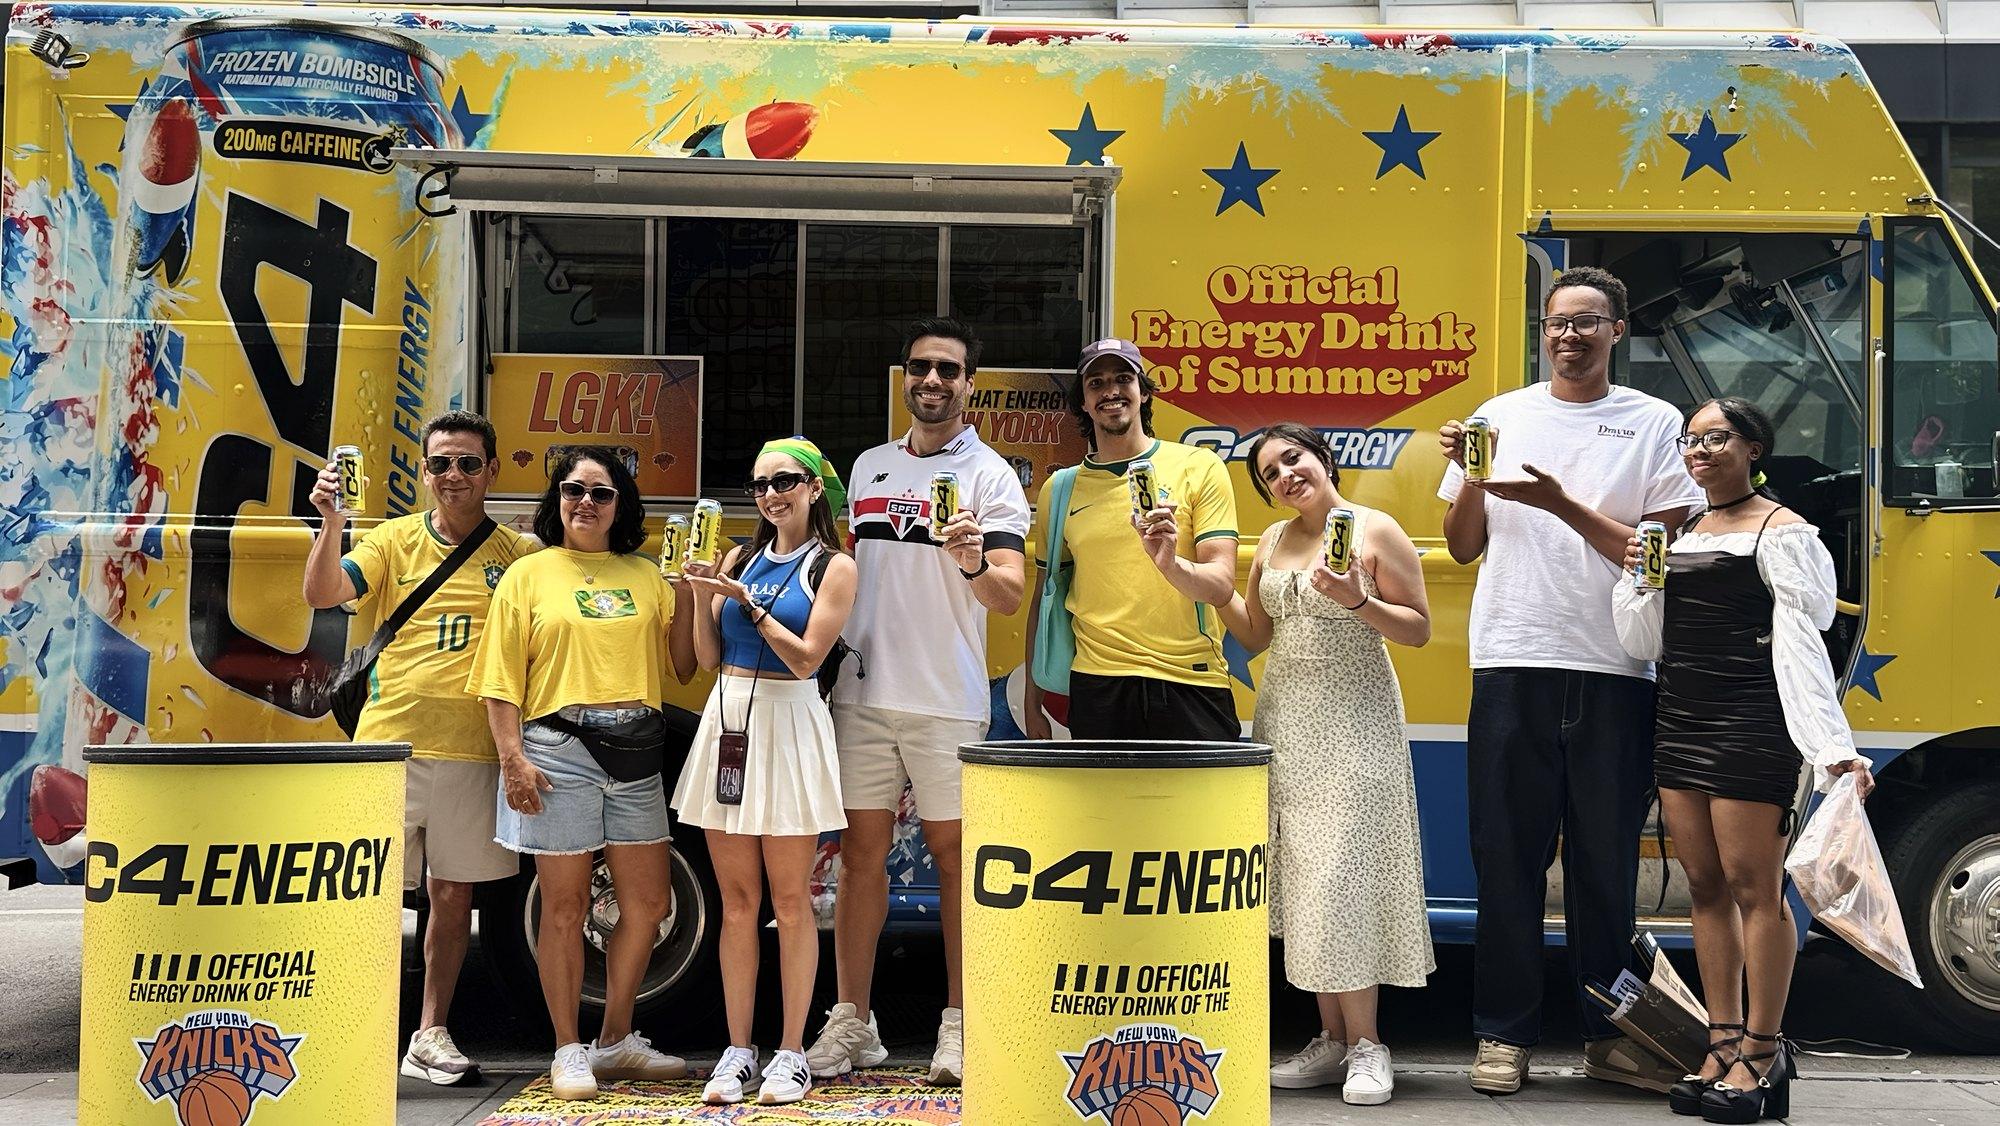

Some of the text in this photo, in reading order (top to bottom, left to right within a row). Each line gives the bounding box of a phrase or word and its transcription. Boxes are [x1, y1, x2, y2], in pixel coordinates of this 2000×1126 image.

[207, 50, 417, 96] FROZEN BOMBSICLE
[223, 74, 399, 103] NATURALLY AND ARTIFICIALLY FLAVORED
[280, 130, 361, 161] CAFFEINE
[1208, 265, 1399, 306] Official
[1132, 309, 1477, 359] Energy Drink
[394, 275, 432, 447] ENERGY
[1146, 355, 1201, 394] of
[527, 371, 664, 435] LGK!
[988, 410, 1065, 444] YORK
[189, 190, 378, 719] C4
[1468, 429, 1480, 467] C4
[345, 459, 359, 497] C4
[1135, 473, 1154, 511] C4
[890, 504, 919, 515] SPFC
[936, 484, 950, 524] C4
[664, 526, 676, 561] C4
[1332, 521, 1347, 560] C4
[1649, 535, 1663, 575] C4
[436, 613, 472, 652] 10
[196, 836, 392, 907] ENERGY
[1122, 842, 1269, 916] ENERGY
[208, 949, 316, 982] OFFICIAL
[1136, 961, 1231, 994] OFFICIAL
[128, 979, 315, 1004] ENERGY DRINK OF THE
[1051, 991, 1230, 1017] ENERGY DRINK OF THE
[184, 1012, 250, 1029] NEW YORK
[1115, 1027, 1178, 1044] NEW YORK
[139, 1023, 296, 1086] KNICKS
[1067, 1038, 1220, 1101] KNICKS
